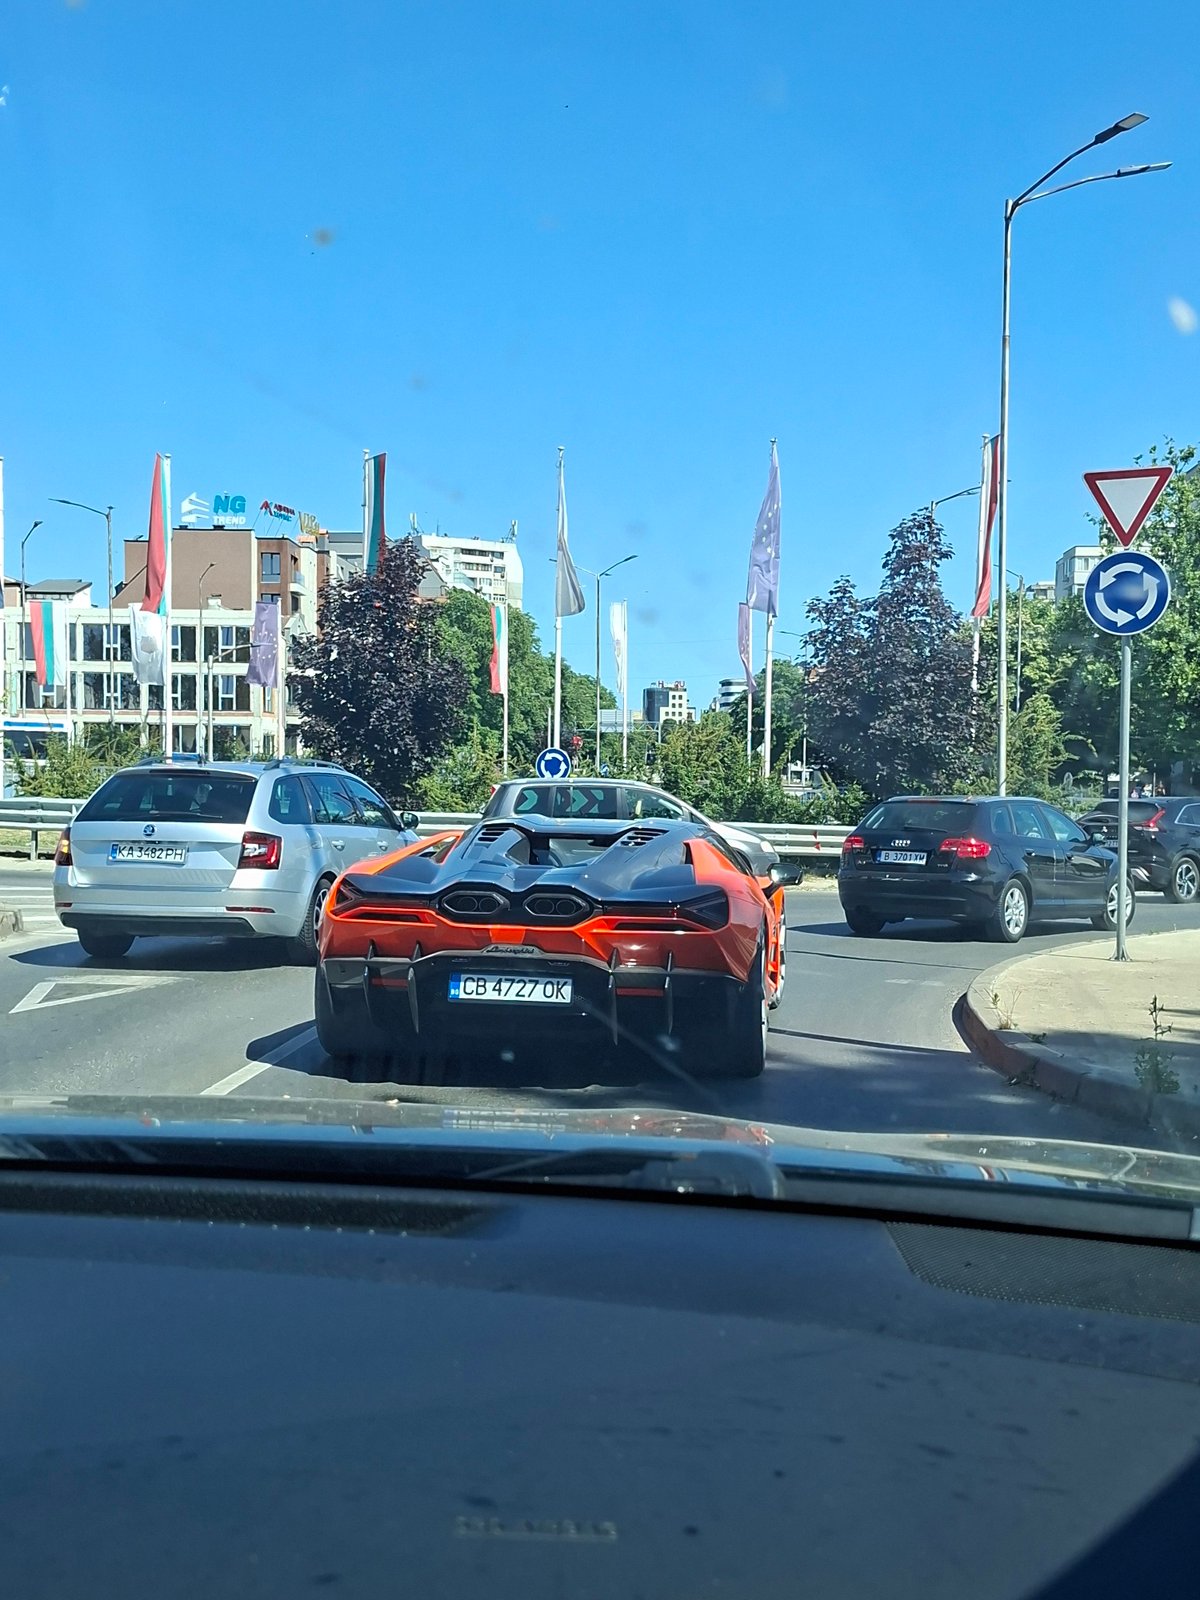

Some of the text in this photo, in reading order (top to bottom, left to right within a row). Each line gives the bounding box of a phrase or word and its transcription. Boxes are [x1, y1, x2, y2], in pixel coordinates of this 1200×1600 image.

[213, 495, 247, 514] NG
[212, 515, 246, 525] TREND
[118, 846, 184, 860] KA 3482 PH
[884, 852, 890, 861] B
[893, 852, 912, 861] 3701
[463, 976, 568, 1000] CB 4727 OK
